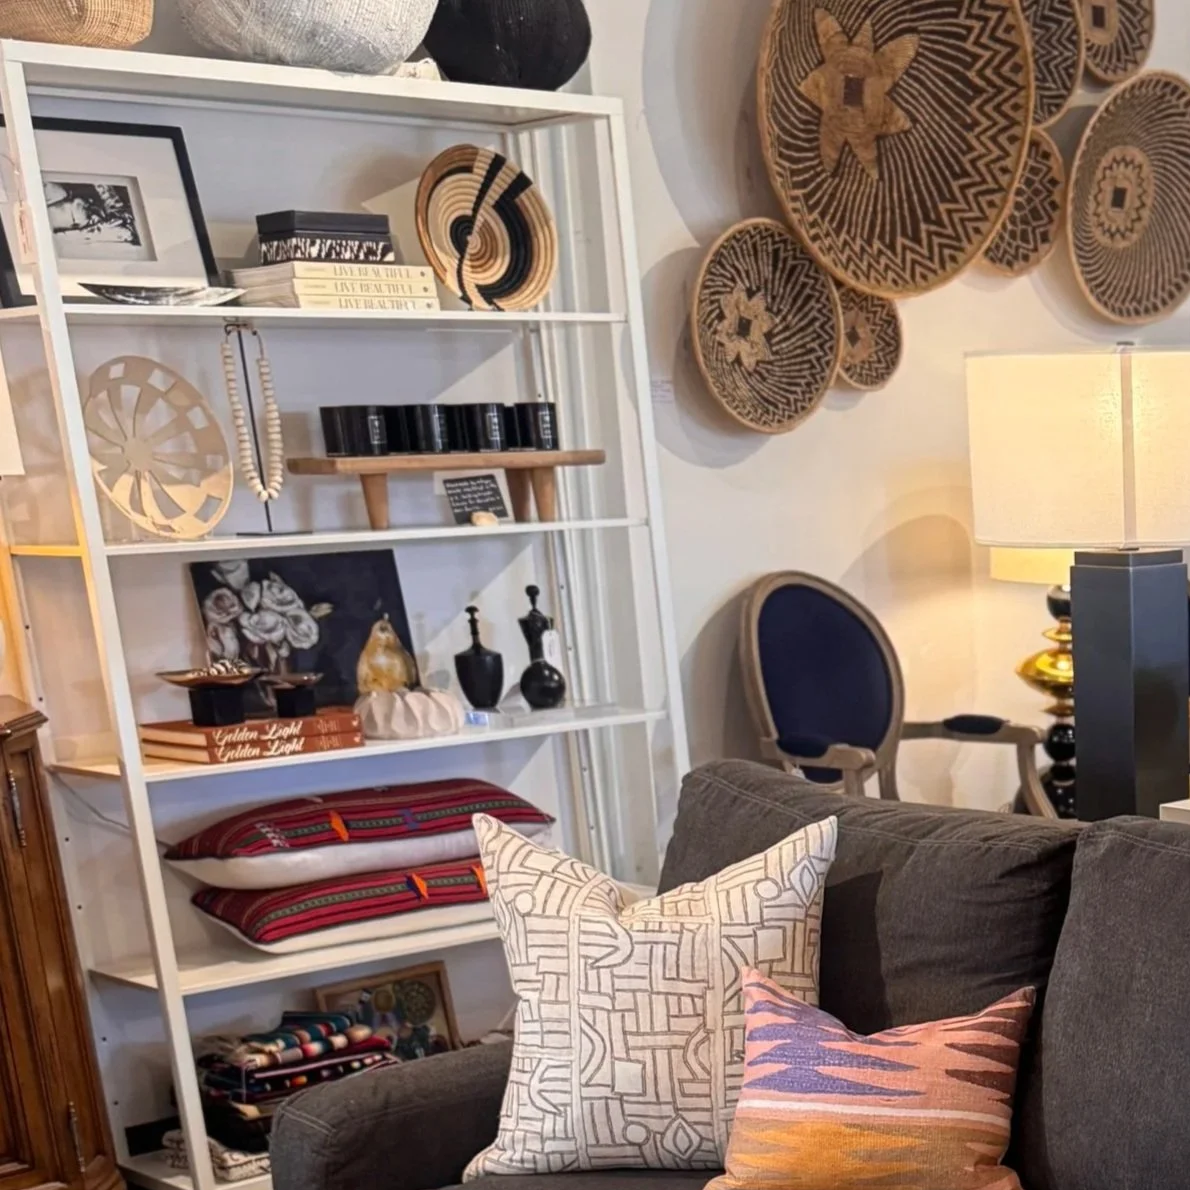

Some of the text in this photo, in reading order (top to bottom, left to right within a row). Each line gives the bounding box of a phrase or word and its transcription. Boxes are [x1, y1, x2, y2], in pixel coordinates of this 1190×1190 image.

[333, 265, 355, 277] LIVE
[358, 266, 412, 278] BEAUTIFUL
[333, 281, 356, 293] LIVE
[360, 283, 414, 295] BEAUTIFUL
[338, 299, 360, 309] LIVE
[212, 727, 259, 747] Golden
[260, 720, 303, 740] Light
[214, 742, 261, 762] Golden
[263, 736, 306, 757] Light
